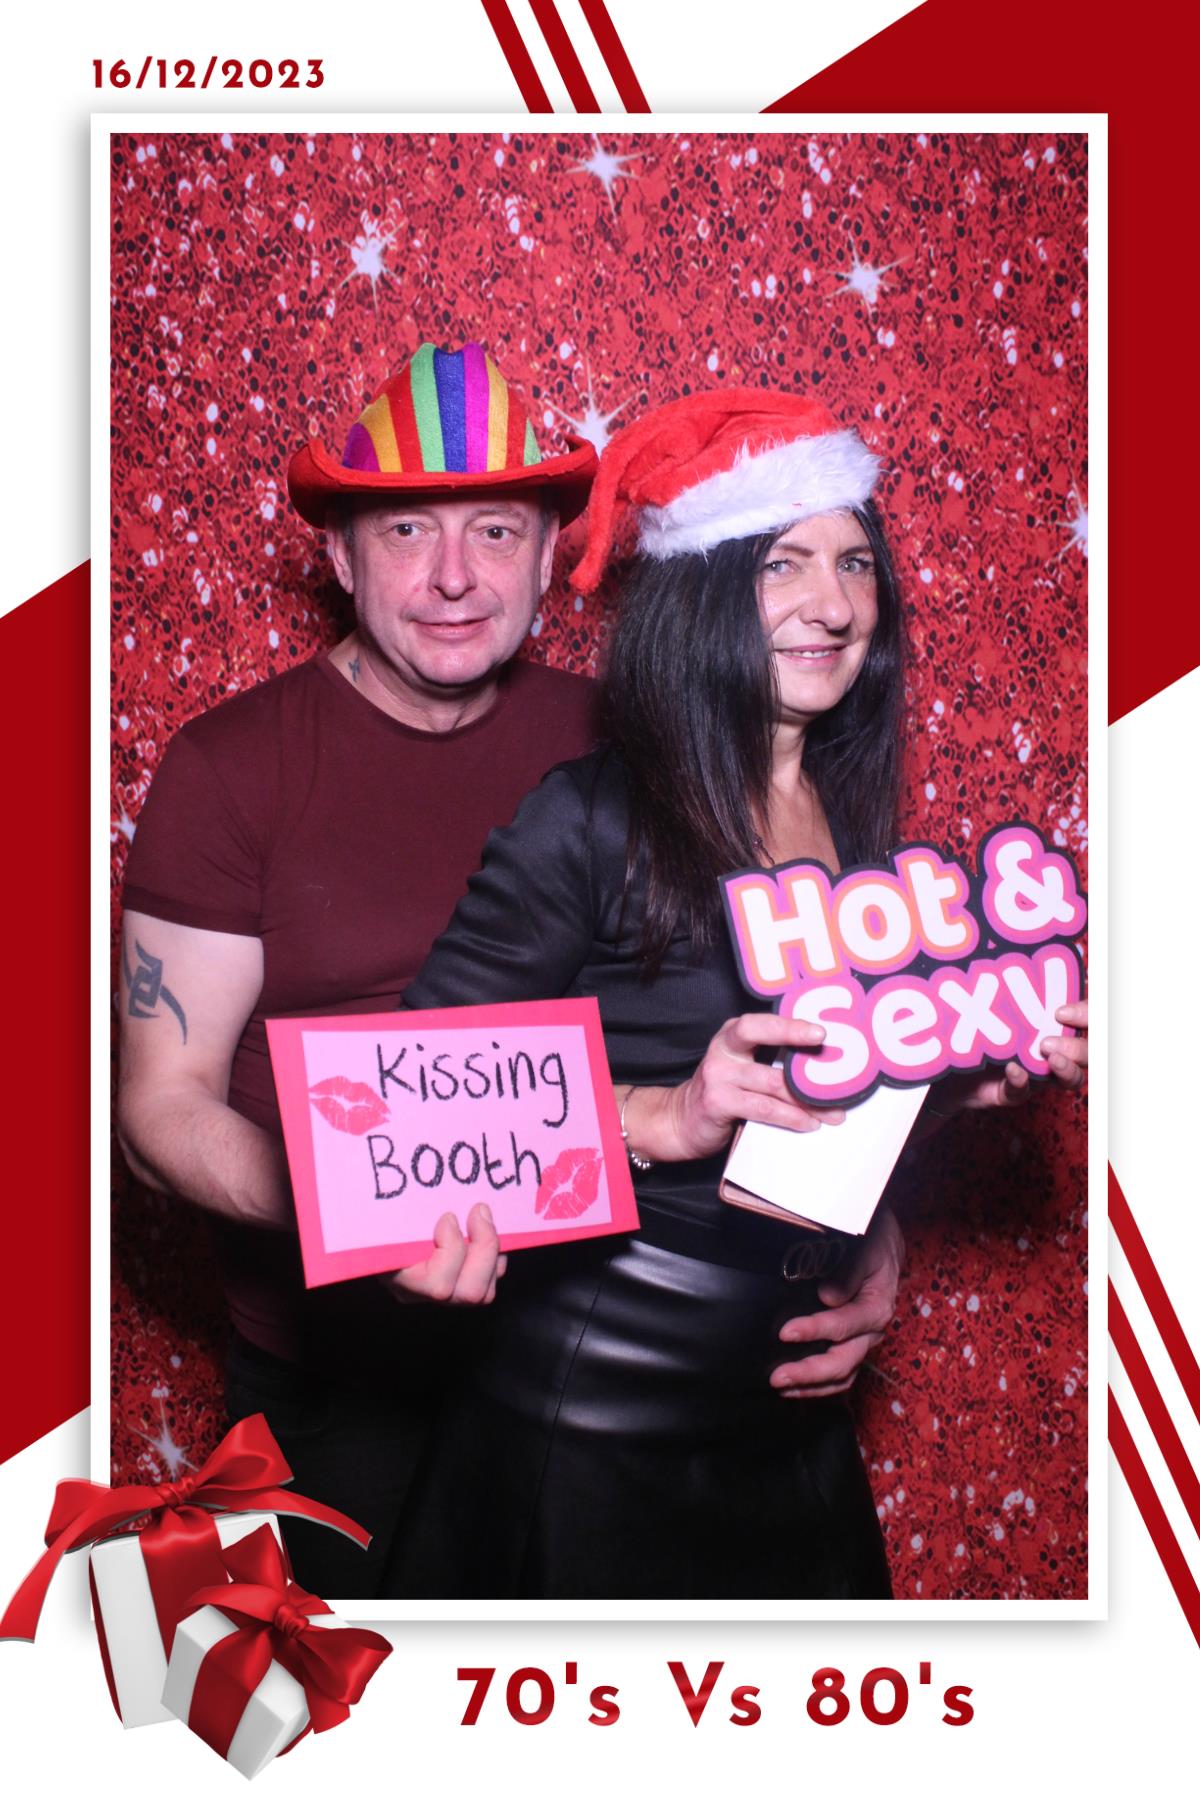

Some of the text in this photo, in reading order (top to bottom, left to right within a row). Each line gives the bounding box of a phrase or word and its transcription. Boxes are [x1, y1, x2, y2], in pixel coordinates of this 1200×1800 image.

[738, 838, 1077, 985] Hot &
[791, 955, 1069, 1087] Sexy
[375, 1040, 570, 1129] Kissing
[366, 1130, 543, 1200] Booth
